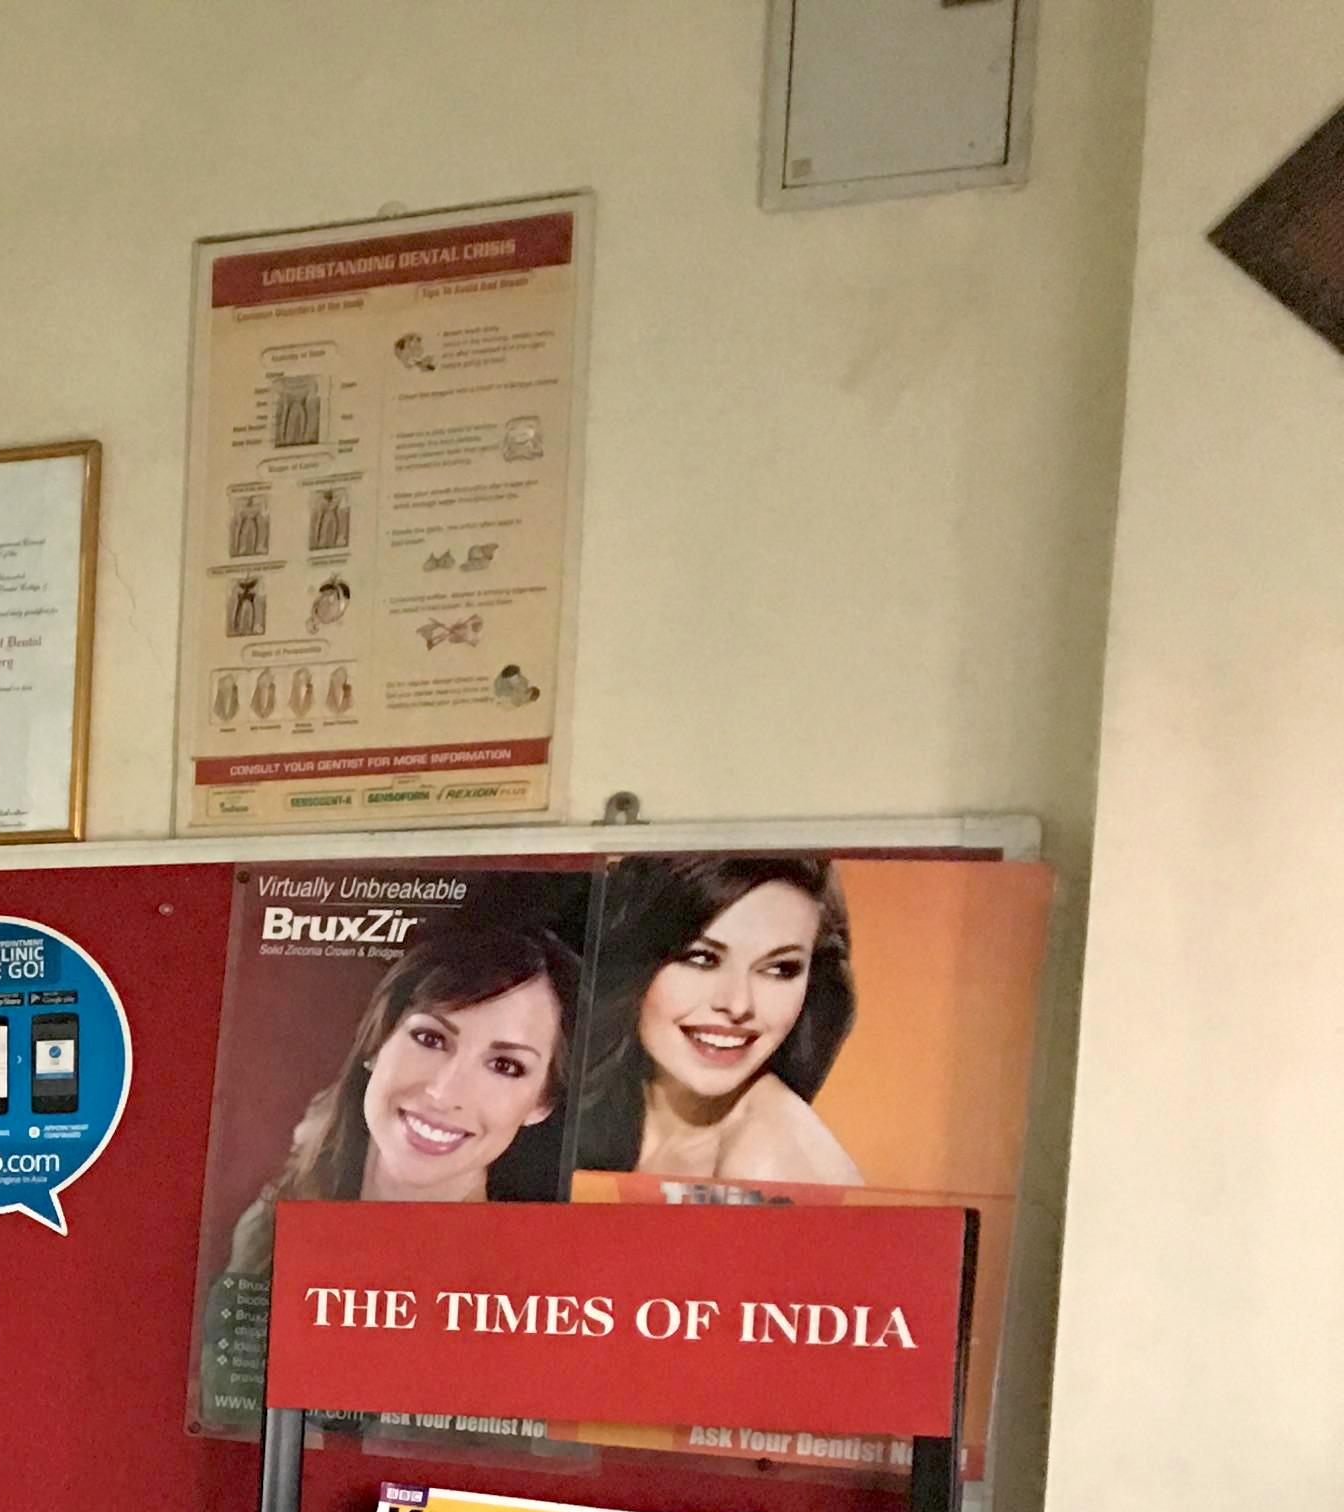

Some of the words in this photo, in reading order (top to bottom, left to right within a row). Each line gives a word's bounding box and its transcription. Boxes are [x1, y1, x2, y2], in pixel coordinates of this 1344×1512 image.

[262, 256, 395, 286] UNDERSTANDING
[399, 245, 459, 267] DENTAL
[464, 239, 516, 261] CRISIS
[230, 762, 281, 777] CONSULT
[283, 760, 314, 773] YOUR
[317, 757, 363, 771] DENTIST
[368, 756, 392, 768] FOR
[394, 754, 428, 767] MORE
[431, 749, 512, 765] INFORMATION
[446, 786, 498, 800] REXIDIN
[258, 876, 335, 903] Virtually
[340, 877, 467, 900] Unbreakable
[262, 906, 418, 943] BruxZir
[8, 960, 45, 979] GO!
[305, 1286, 417, 1330] THE
[438, 1290, 615, 1337] TIMES
[636, 1297, 720, 1340] OF
[740, 1302, 919, 1349] INDIA
[689, 1425, 733, 1449] Ask
[738, 1427, 792, 1454] Your
[796, 1432, 885, 1464] Dentist
